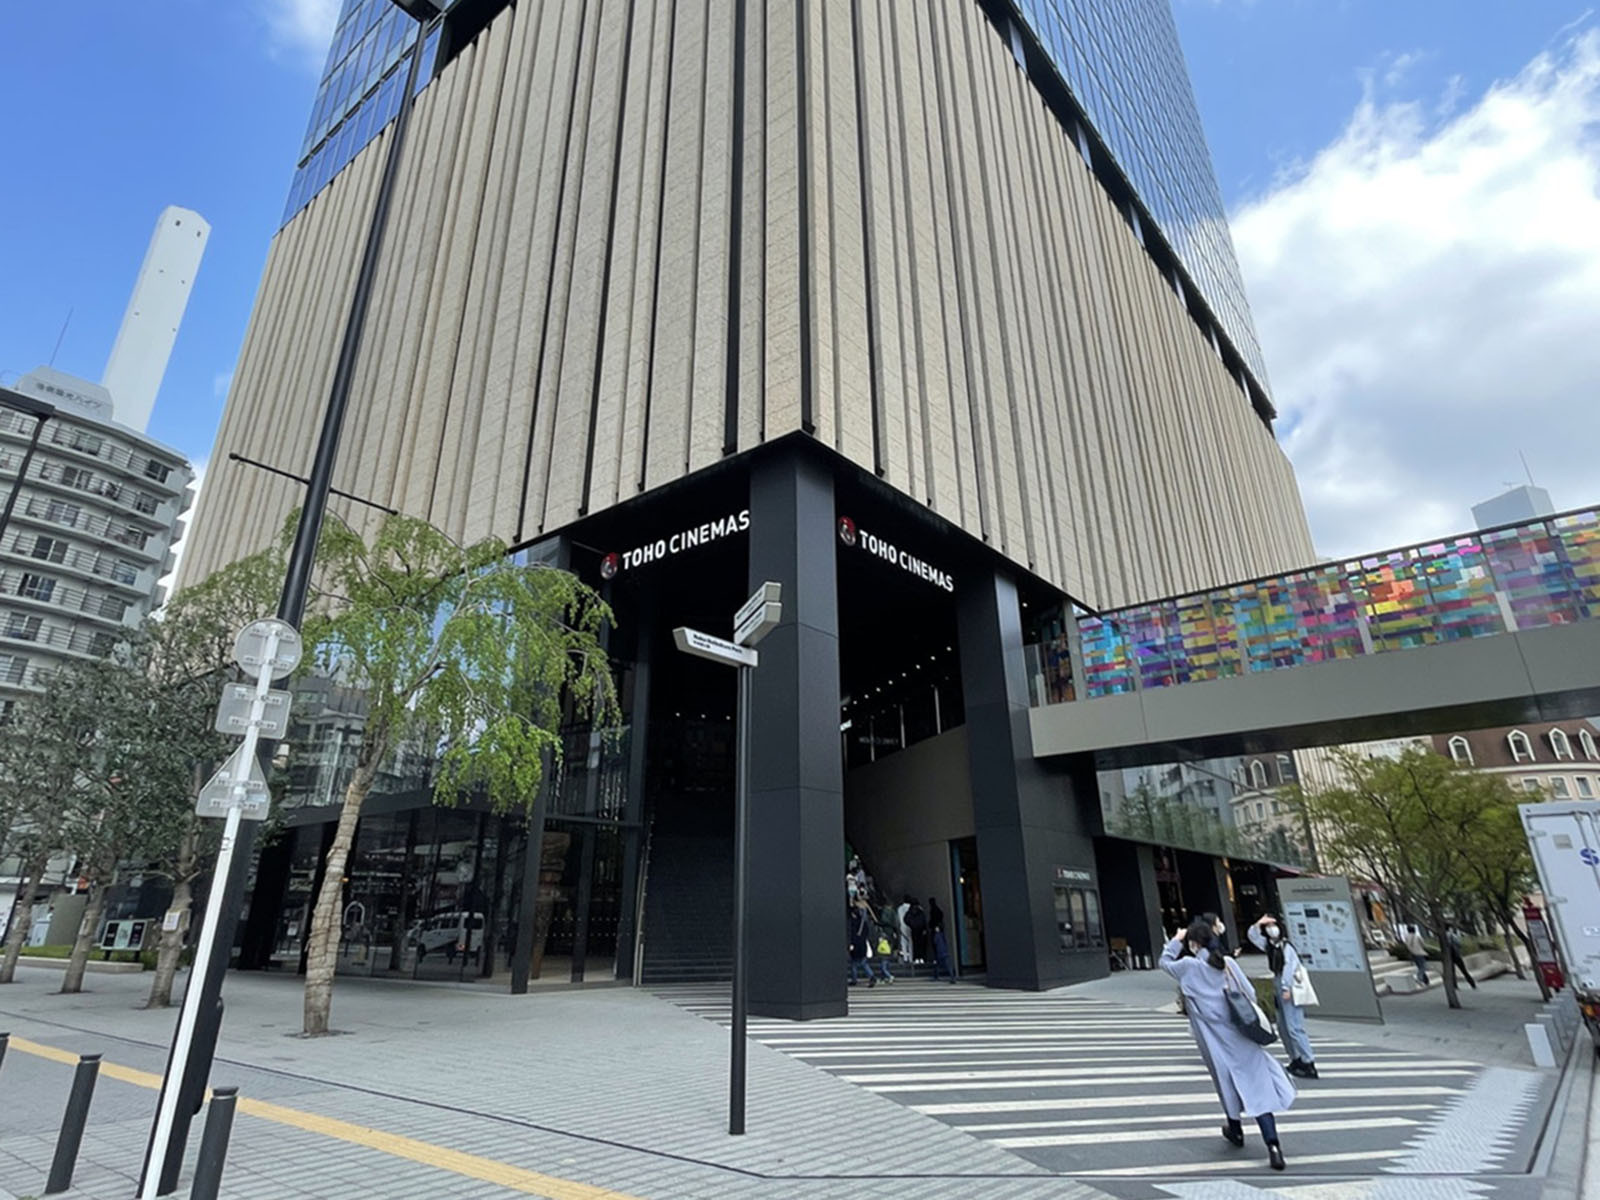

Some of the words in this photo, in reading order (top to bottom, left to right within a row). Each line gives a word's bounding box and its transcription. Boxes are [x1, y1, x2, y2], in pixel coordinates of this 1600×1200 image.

[622, 539, 666, 570] TOHO
[669, 509, 750, 554] CINEMAS
[859, 529, 897, 564] TOHO
[899, 550, 954, 592] CINEMAS
